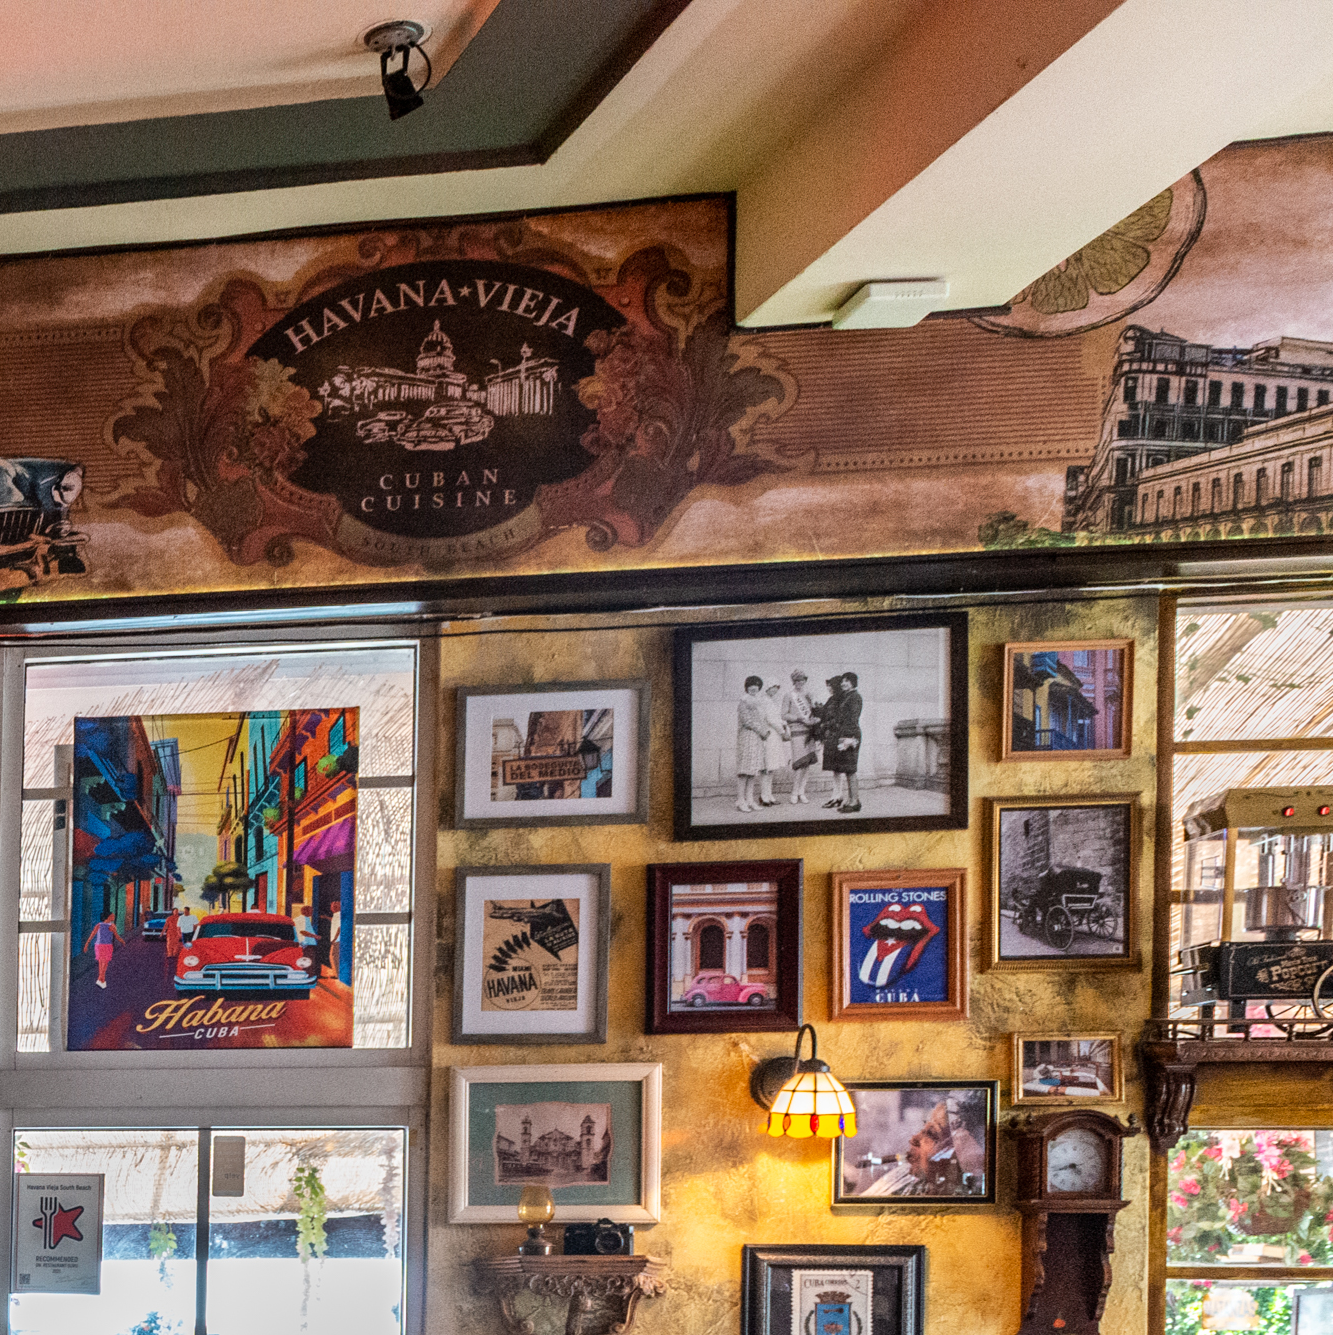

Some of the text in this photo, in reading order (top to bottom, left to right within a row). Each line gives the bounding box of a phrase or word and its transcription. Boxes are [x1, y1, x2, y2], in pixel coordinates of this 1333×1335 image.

[284, 278, 583, 354] HAVANA VIEJA
[379, 468, 500, 490] CUBAN
[360, 489, 517, 513] CUISINE
[362, 529, 515, 557] SOUTH BEACH
[510, 768, 581, 780] DEL MEDIO
[849, 890, 947, 904] ROLLING STONES
[487, 972, 539, 998] HAVANA
[875, 993, 920, 1003] CUBA
[136, 995, 288, 1033] Habana
[194, 1025, 239, 1040] CUBA
[35, 1255, 79, 1263] RECOMMENDED
